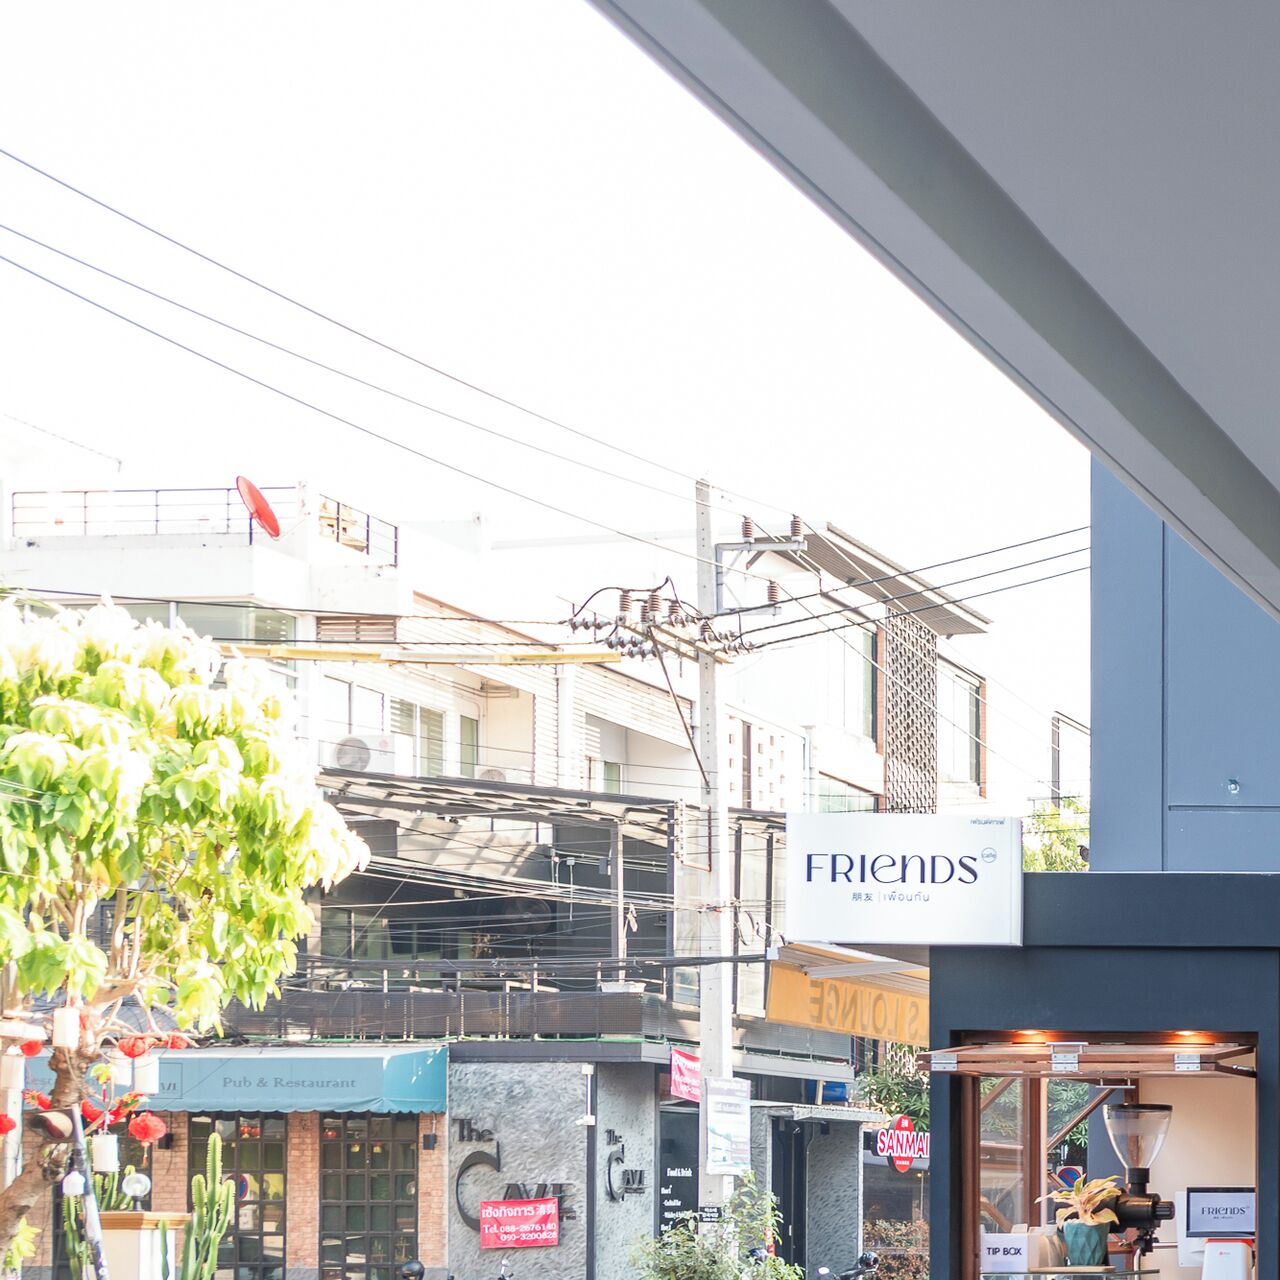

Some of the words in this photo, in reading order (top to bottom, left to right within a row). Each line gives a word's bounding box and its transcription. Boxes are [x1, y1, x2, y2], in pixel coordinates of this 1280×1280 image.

[852, 892, 873, 902] 朋友
[883, 890, 930, 902] เพื่อนกัน
[222, 1077, 251, 1088] Pub
[256, 1077, 265, 1088] &
[273, 1077, 356, 1088] Restaurant
[452, 1118, 494, 1142] The
[604, 1129, 622, 1145] The
[877, 1128, 930, 1158] SANMAI
[986, 1246, 1001, 1256] TIP
[1003, 1246, 1022, 1256] BOX
